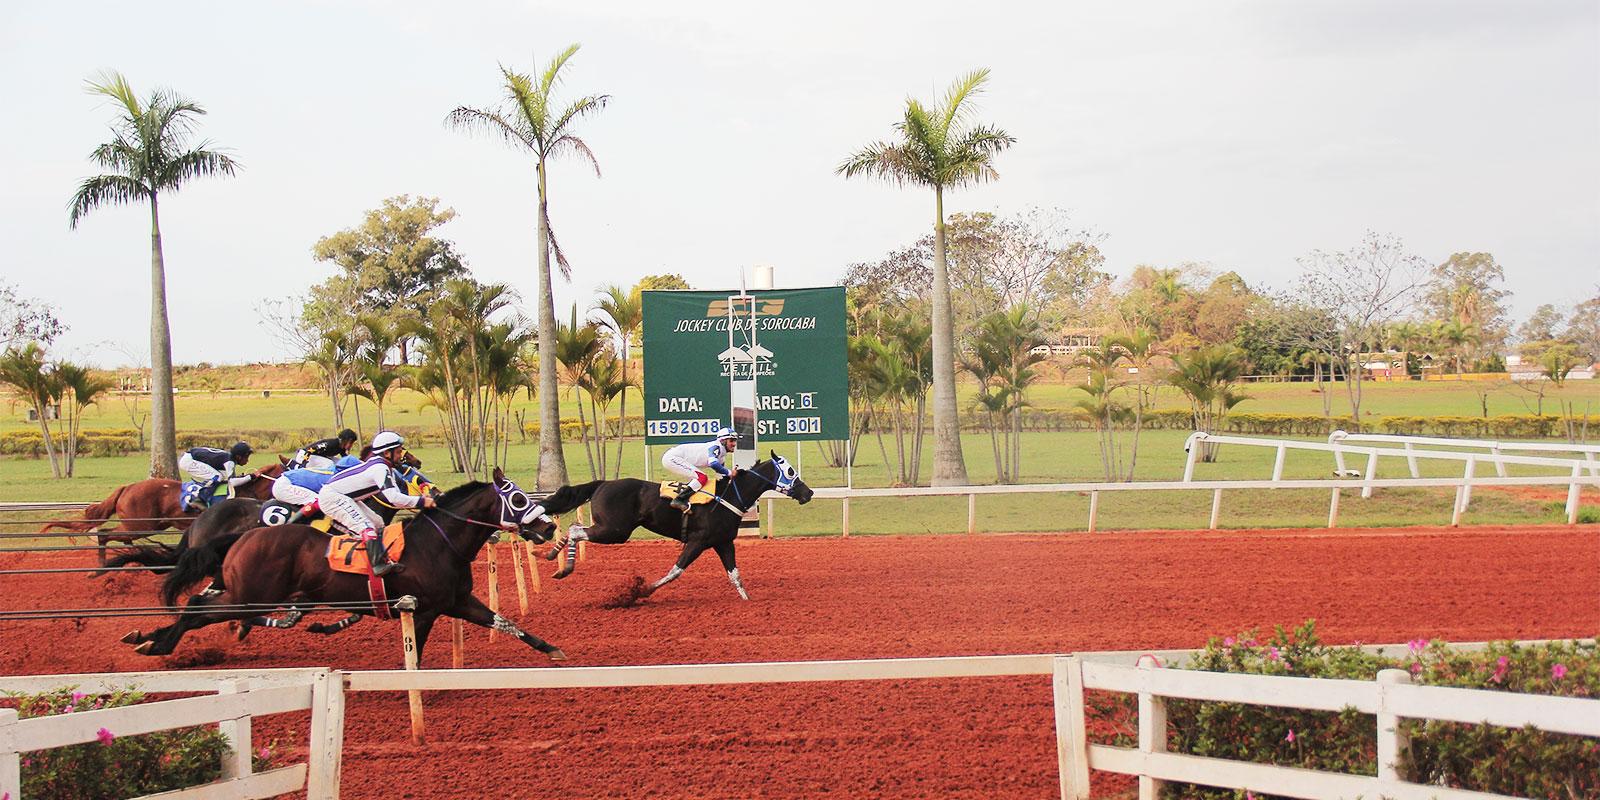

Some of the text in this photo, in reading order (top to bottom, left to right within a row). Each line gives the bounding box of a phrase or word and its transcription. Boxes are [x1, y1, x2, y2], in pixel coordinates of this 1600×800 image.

[674, 319, 716, 333] JOCKEY
[716, 318, 743, 332] CLUB
[761, 316, 816, 331] SOROCABA
[659, 397, 703, 412] DATA:
[756, 392, 811, 410] ÁREO: 6
[649, 420, 720, 435] 1592018
[757, 419, 780, 434] ST:
[262, 505, 289, 527] 6
[338, 538, 363, 566] 7
[404, 636, 413, 652] 8
